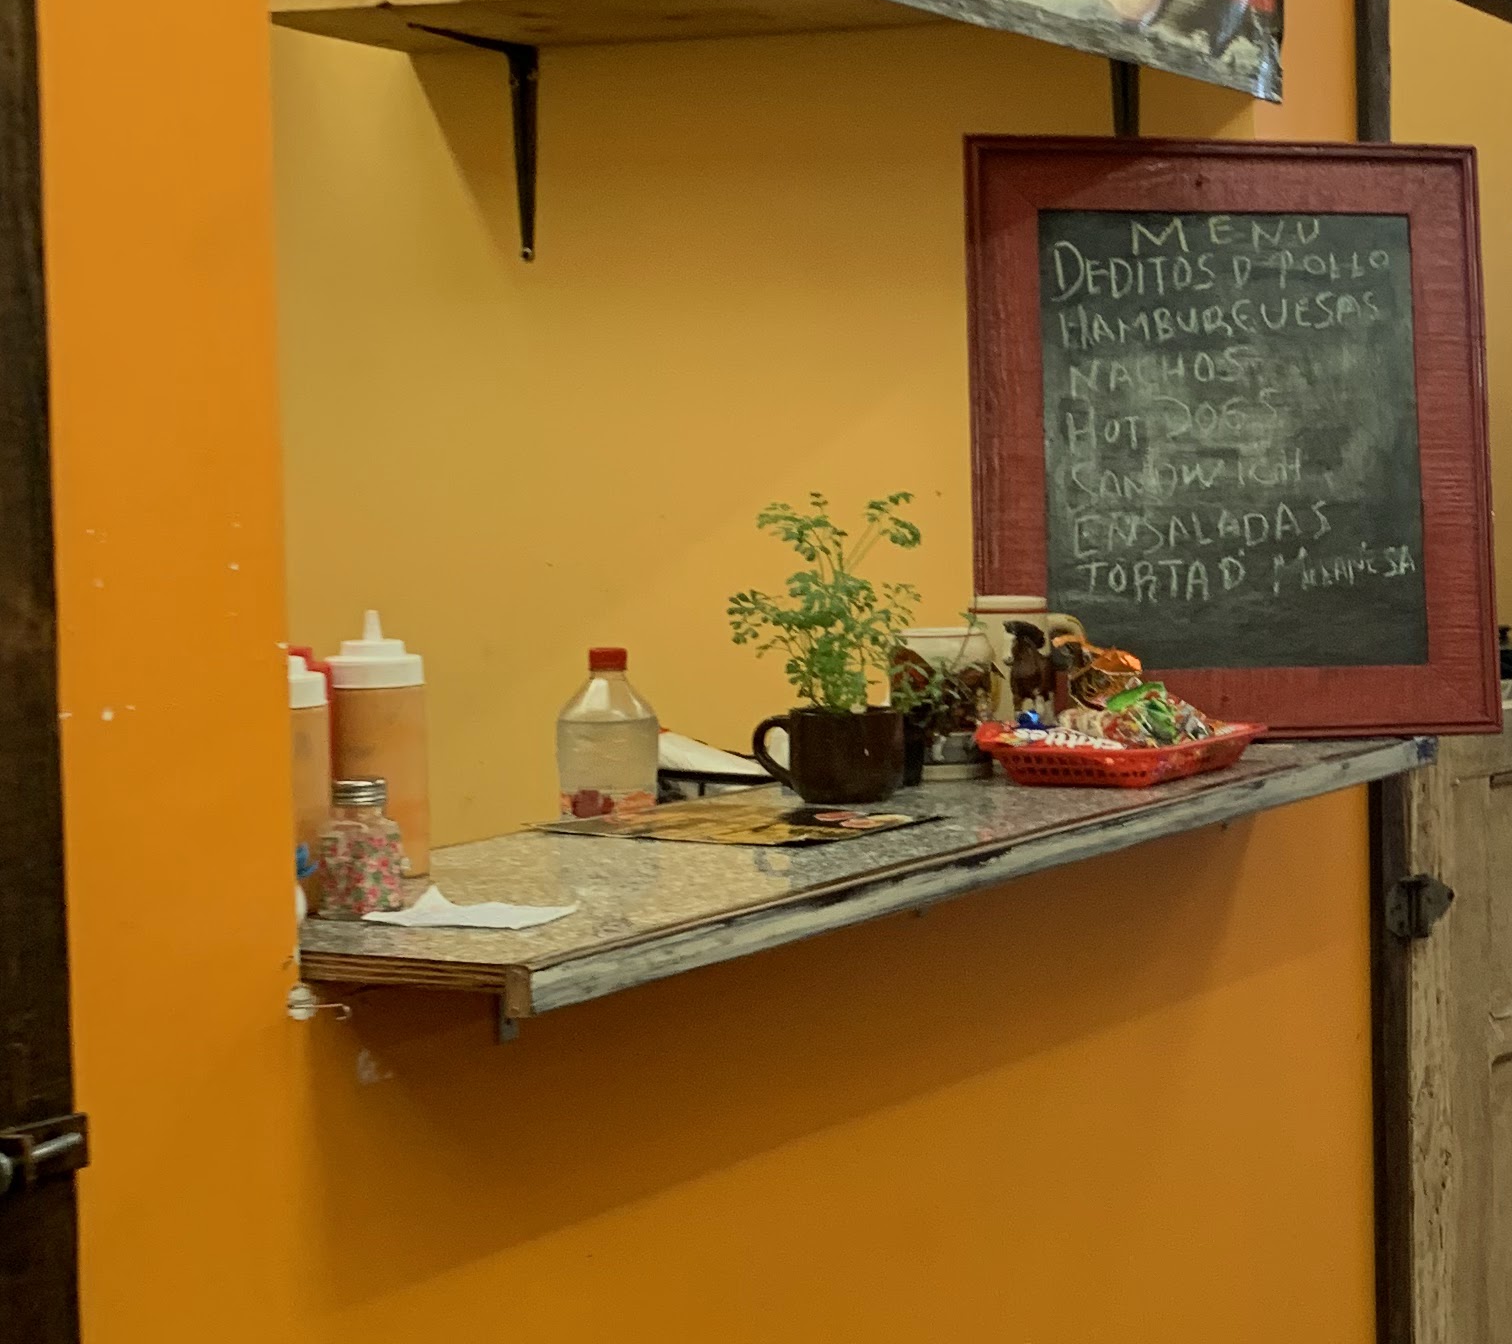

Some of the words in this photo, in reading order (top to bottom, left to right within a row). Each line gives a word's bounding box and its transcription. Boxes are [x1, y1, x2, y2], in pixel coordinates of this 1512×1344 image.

[1131, 216, 1321, 255] MENU
[1051, 240, 1216, 302] DEDITOS
[1276, 250, 1389, 289] POLLO
[1070, 346, 1250, 400] NACHOS
[1066, 405, 1140, 456] HOT
[1152, 388, 1280, 438] DOGS
[1071, 448, 1301, 504] SANDWICH
[1074, 500, 1332, 558] ENSALADAS
